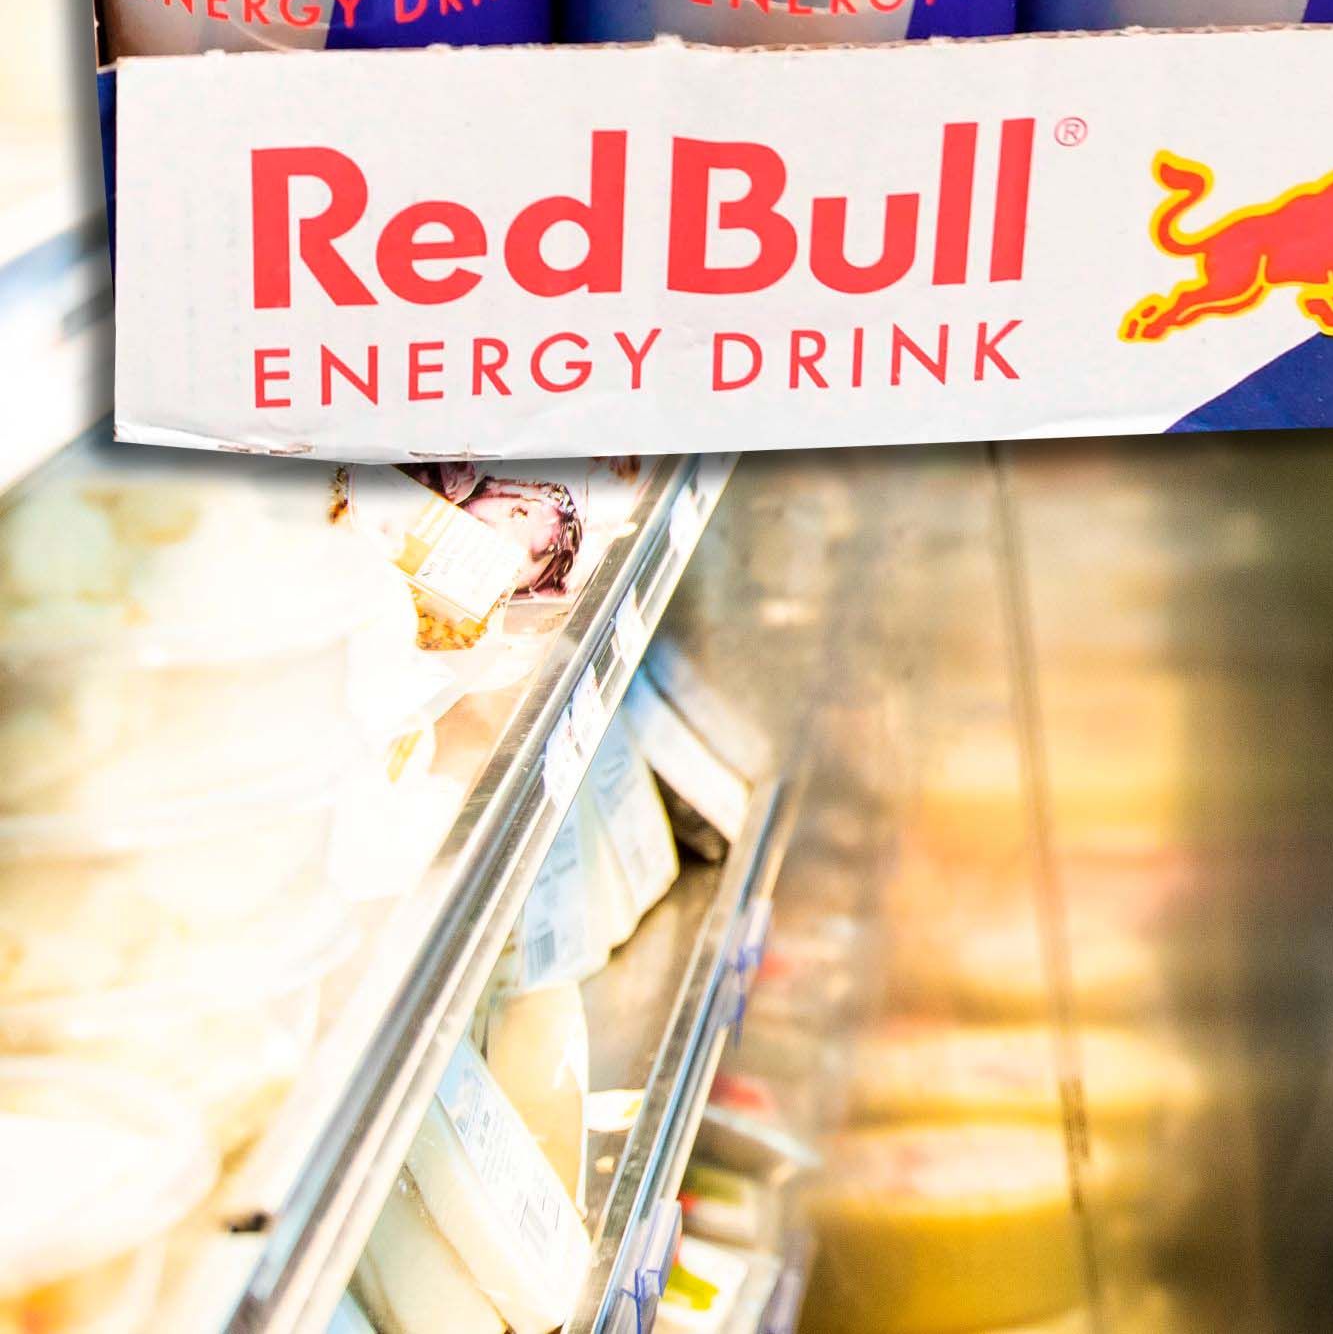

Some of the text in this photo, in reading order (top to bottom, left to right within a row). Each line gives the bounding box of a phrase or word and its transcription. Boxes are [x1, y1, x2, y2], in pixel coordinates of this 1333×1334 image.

[250, 129, 628, 310] Red
[666, 117, 1037, 296] Bull
[254, 319, 1024, 409] ENERGY DRINK
